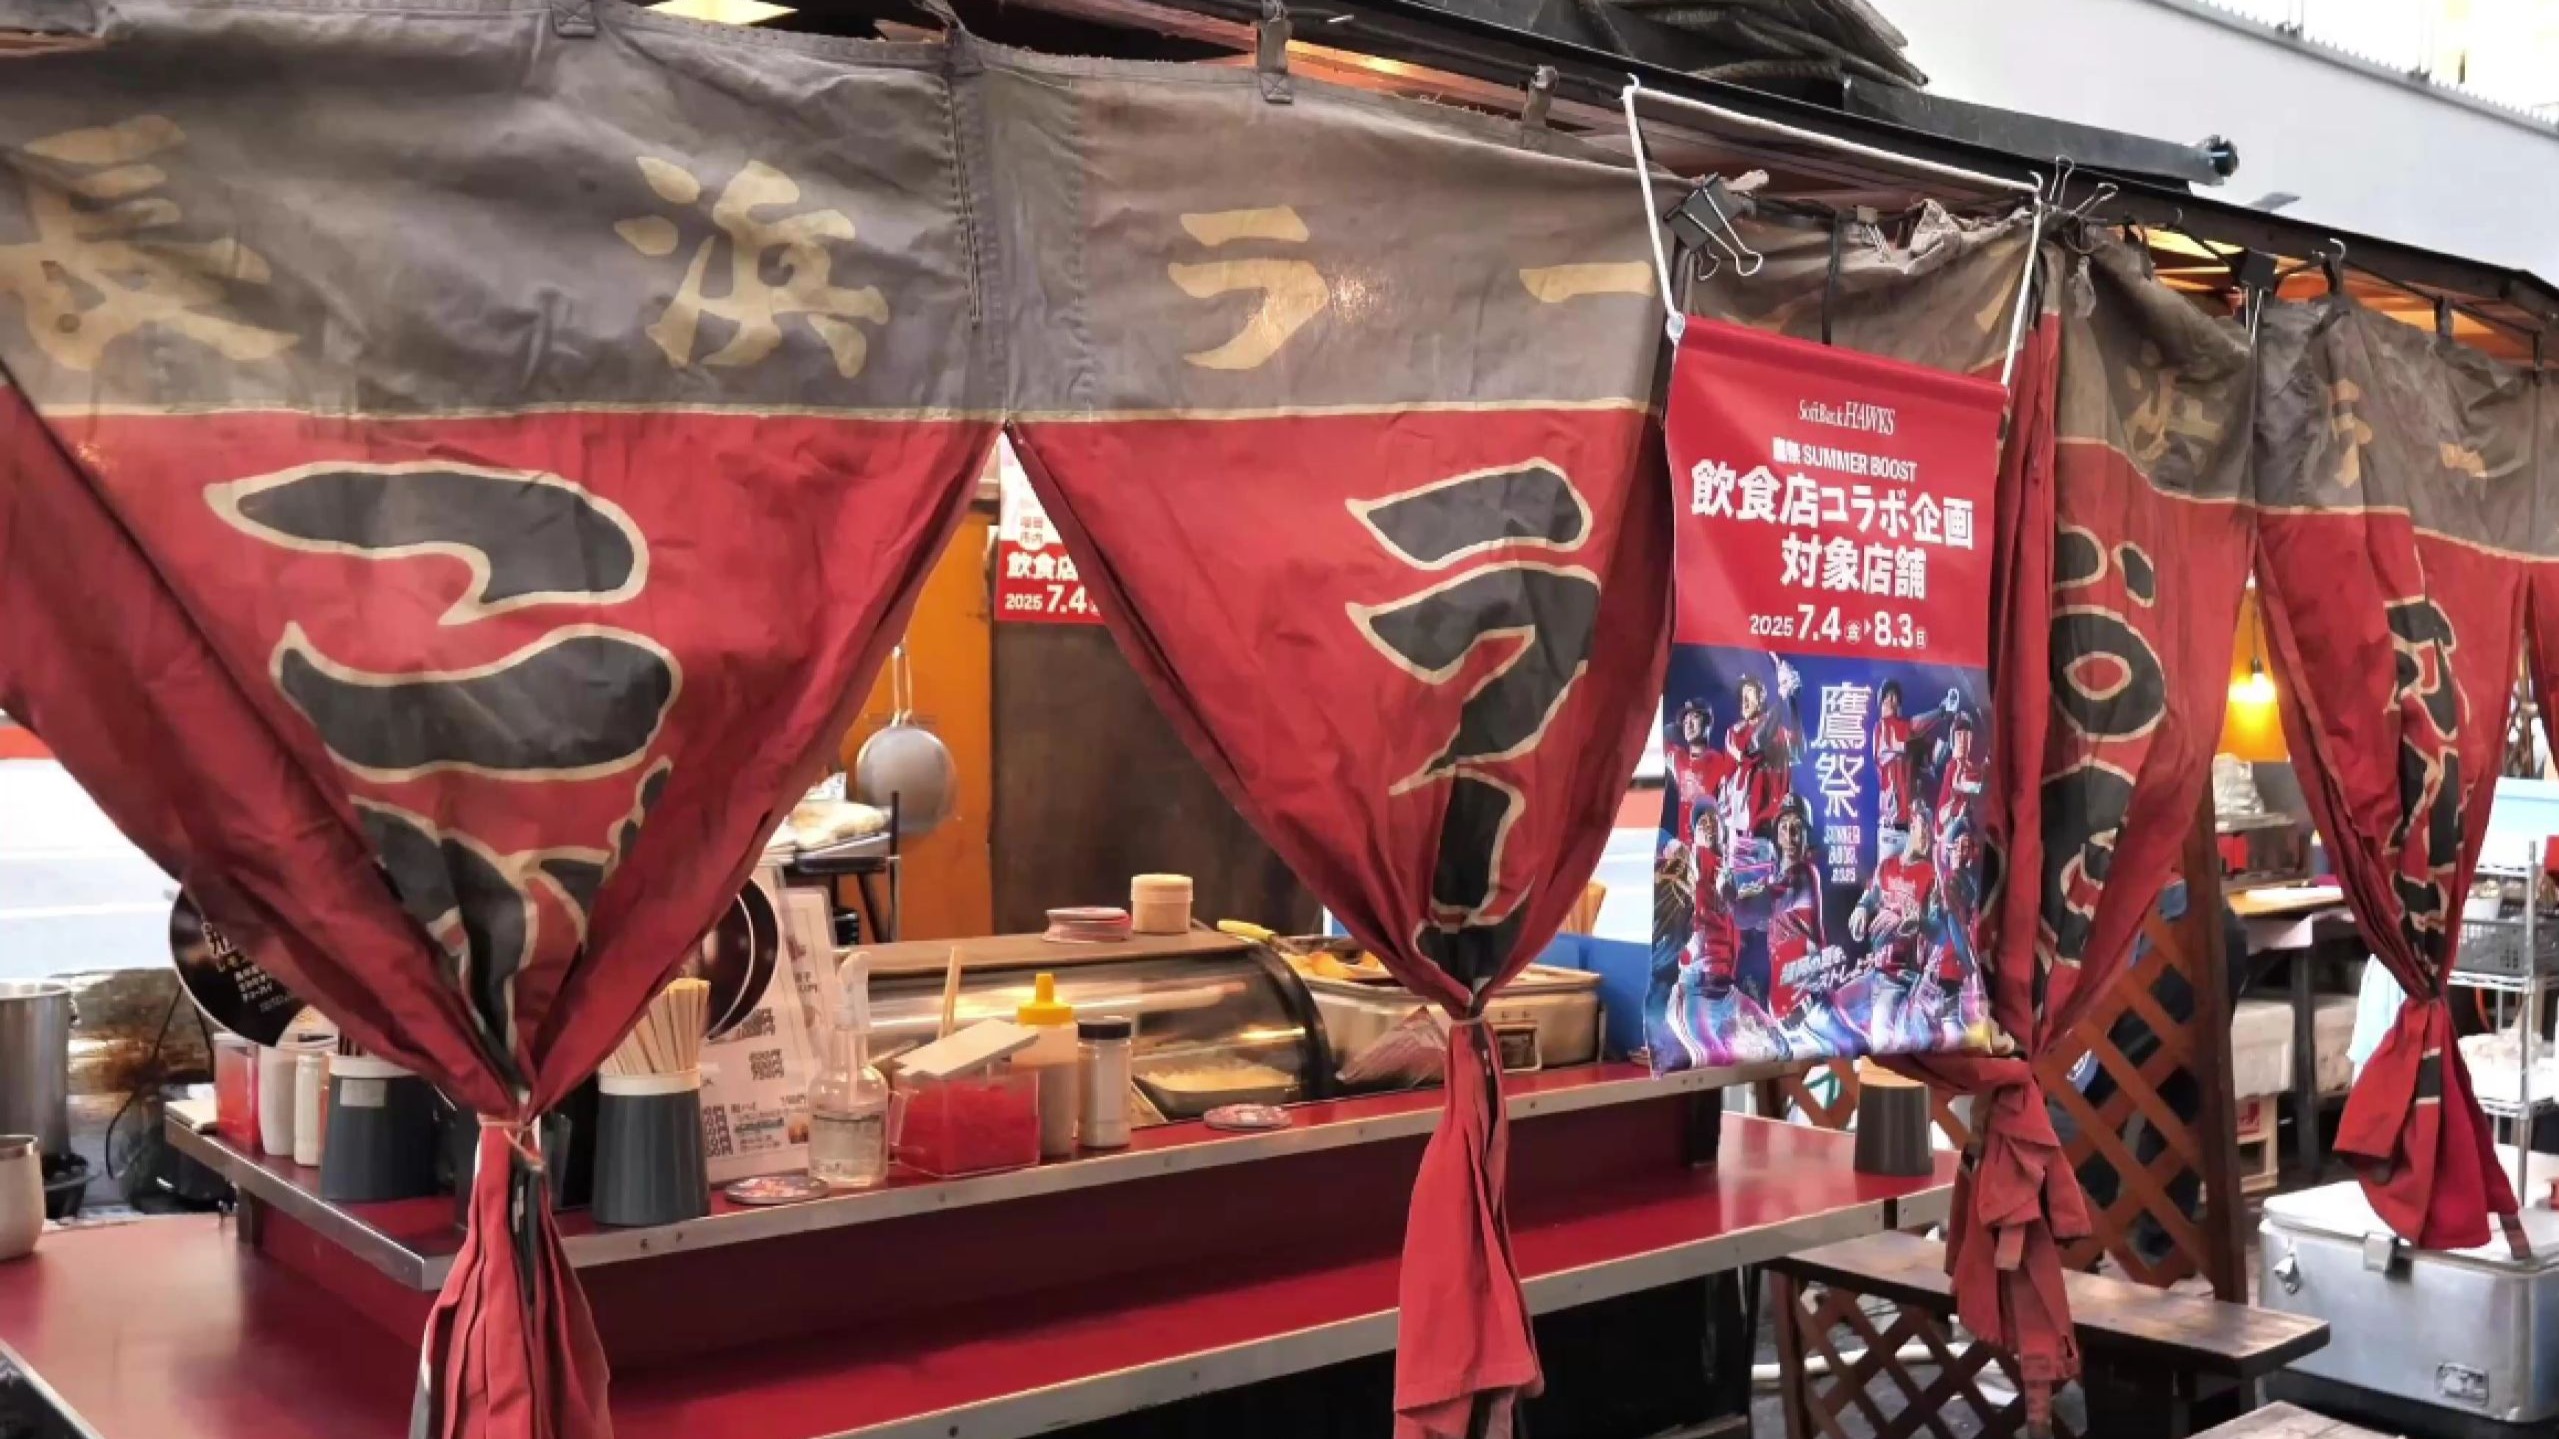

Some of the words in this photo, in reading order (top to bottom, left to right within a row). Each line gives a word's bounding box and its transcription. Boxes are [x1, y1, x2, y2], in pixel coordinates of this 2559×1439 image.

[1803, 442, 1867, 475] SUMMER
[1870, 456, 1917, 482] BOOST
[1691, 459, 1974, 550] 飲食店コラボ企画
[1780, 532, 1928, 600] 対象店舗
[1005, 593, 1044, 611] 2025
[1749, 614, 1794, 638] 2025
[1810, 682, 1873, 818] 鷹祭
